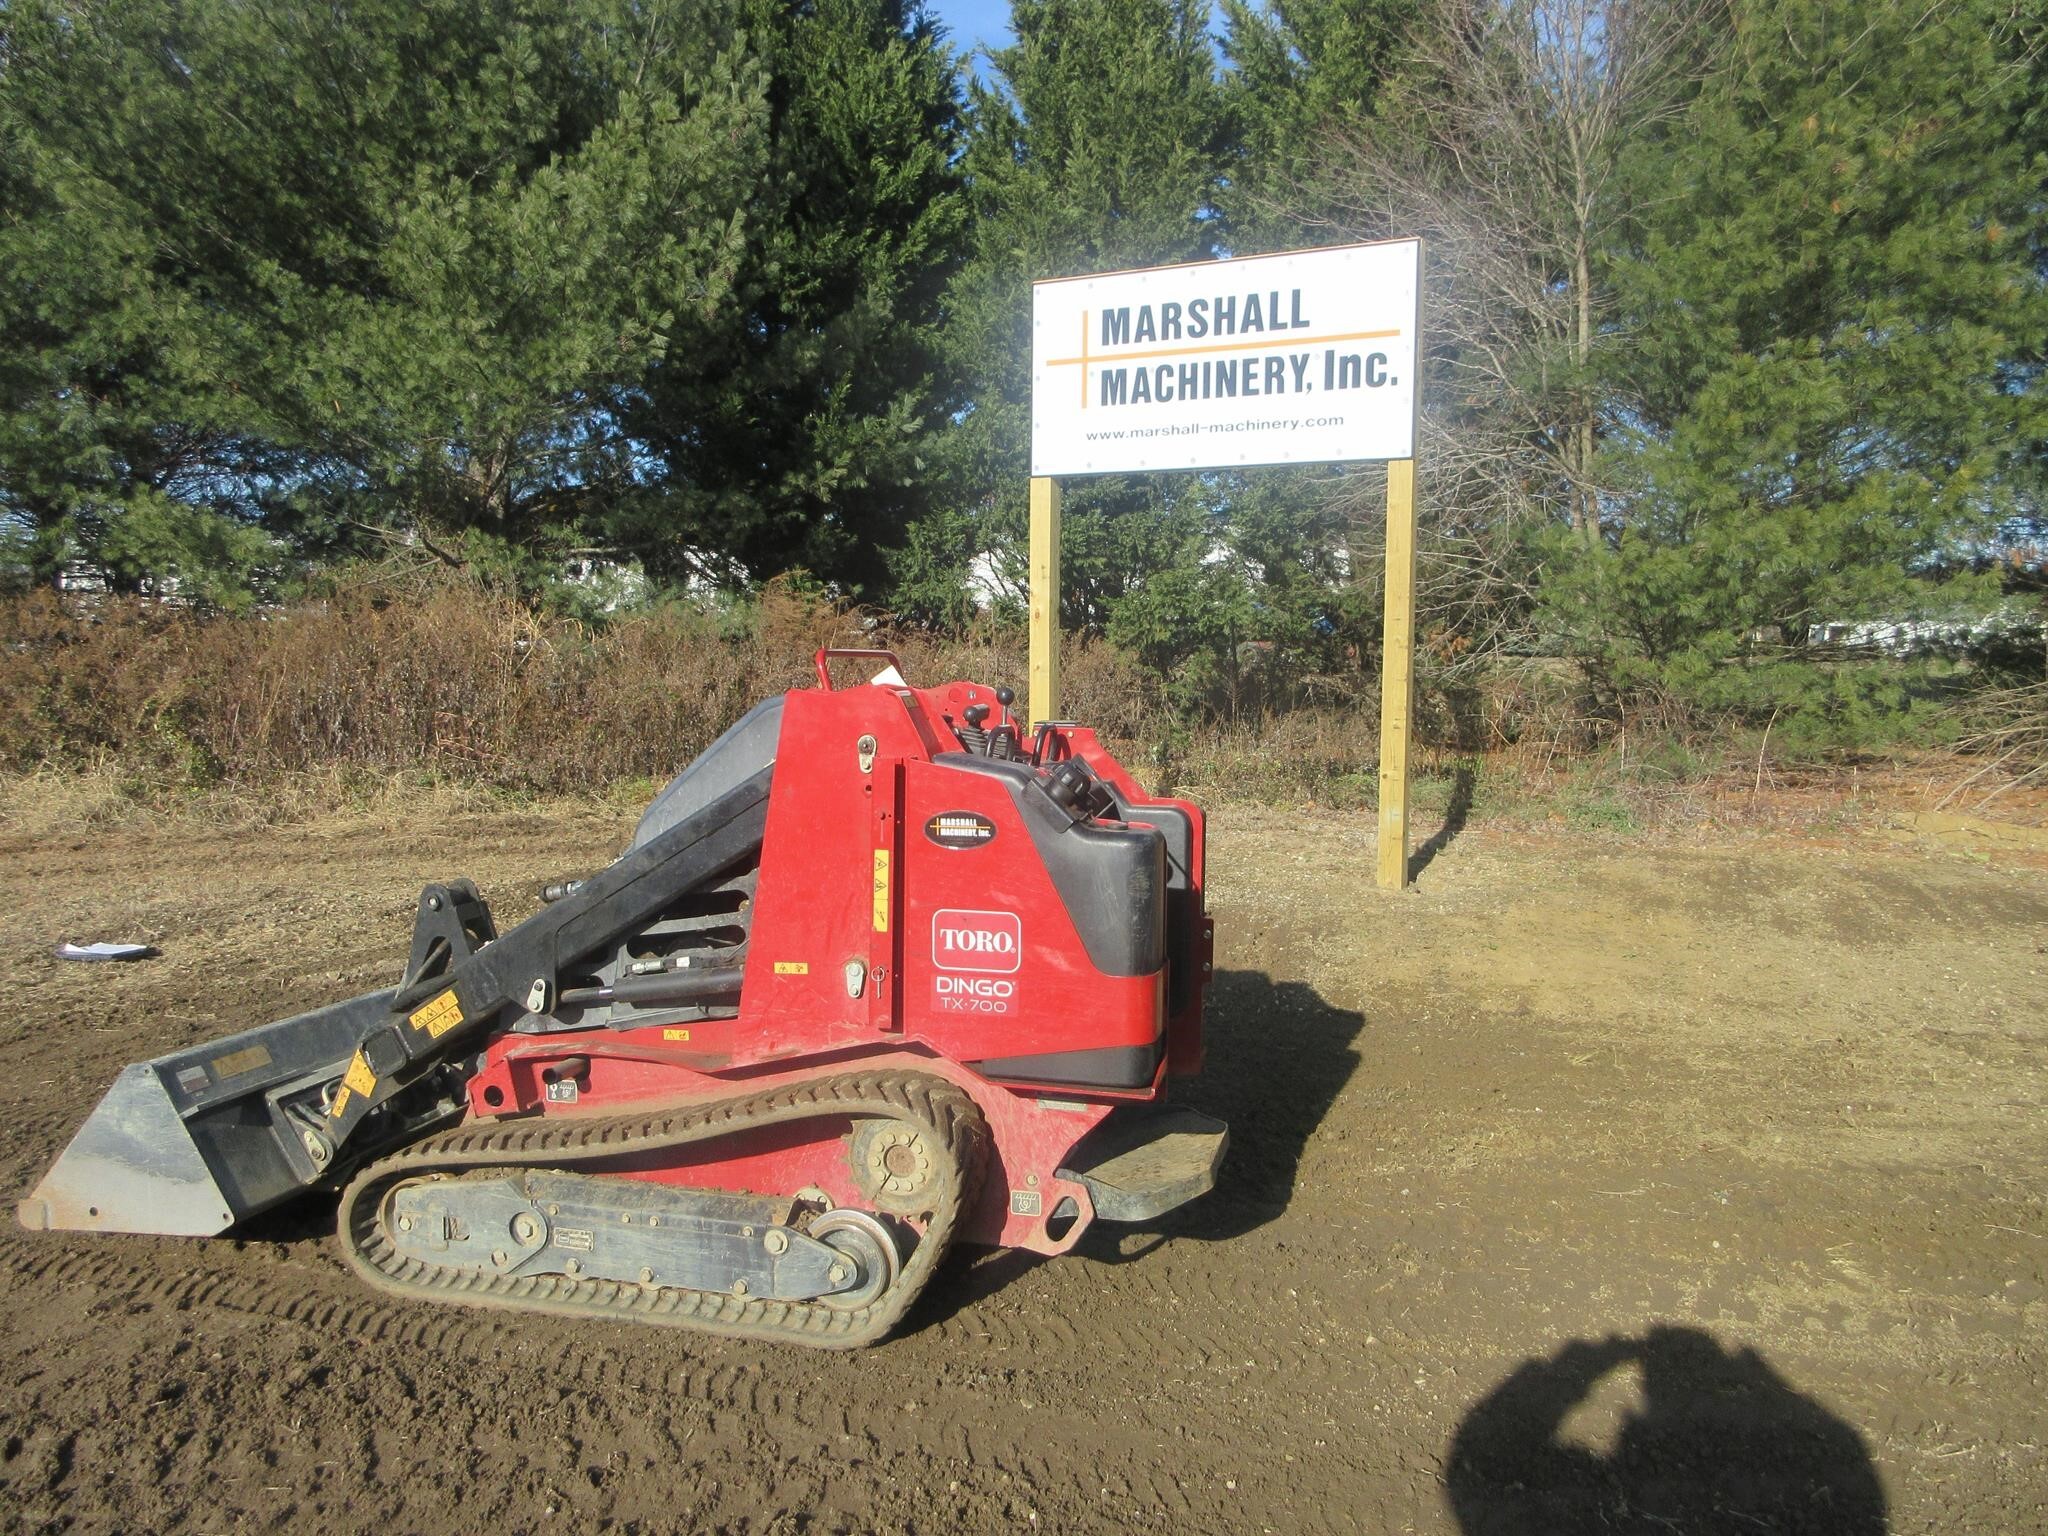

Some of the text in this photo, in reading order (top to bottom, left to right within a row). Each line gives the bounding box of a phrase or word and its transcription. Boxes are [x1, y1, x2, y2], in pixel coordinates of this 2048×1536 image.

[1101, 288, 1310, 346] MARSHALL
[1100, 349, 1398, 406] MACHINERY, Inc.
[1086, 415, 1344, 441] www.marshall-machinery.com
[937, 976, 1013, 997] DINGO
